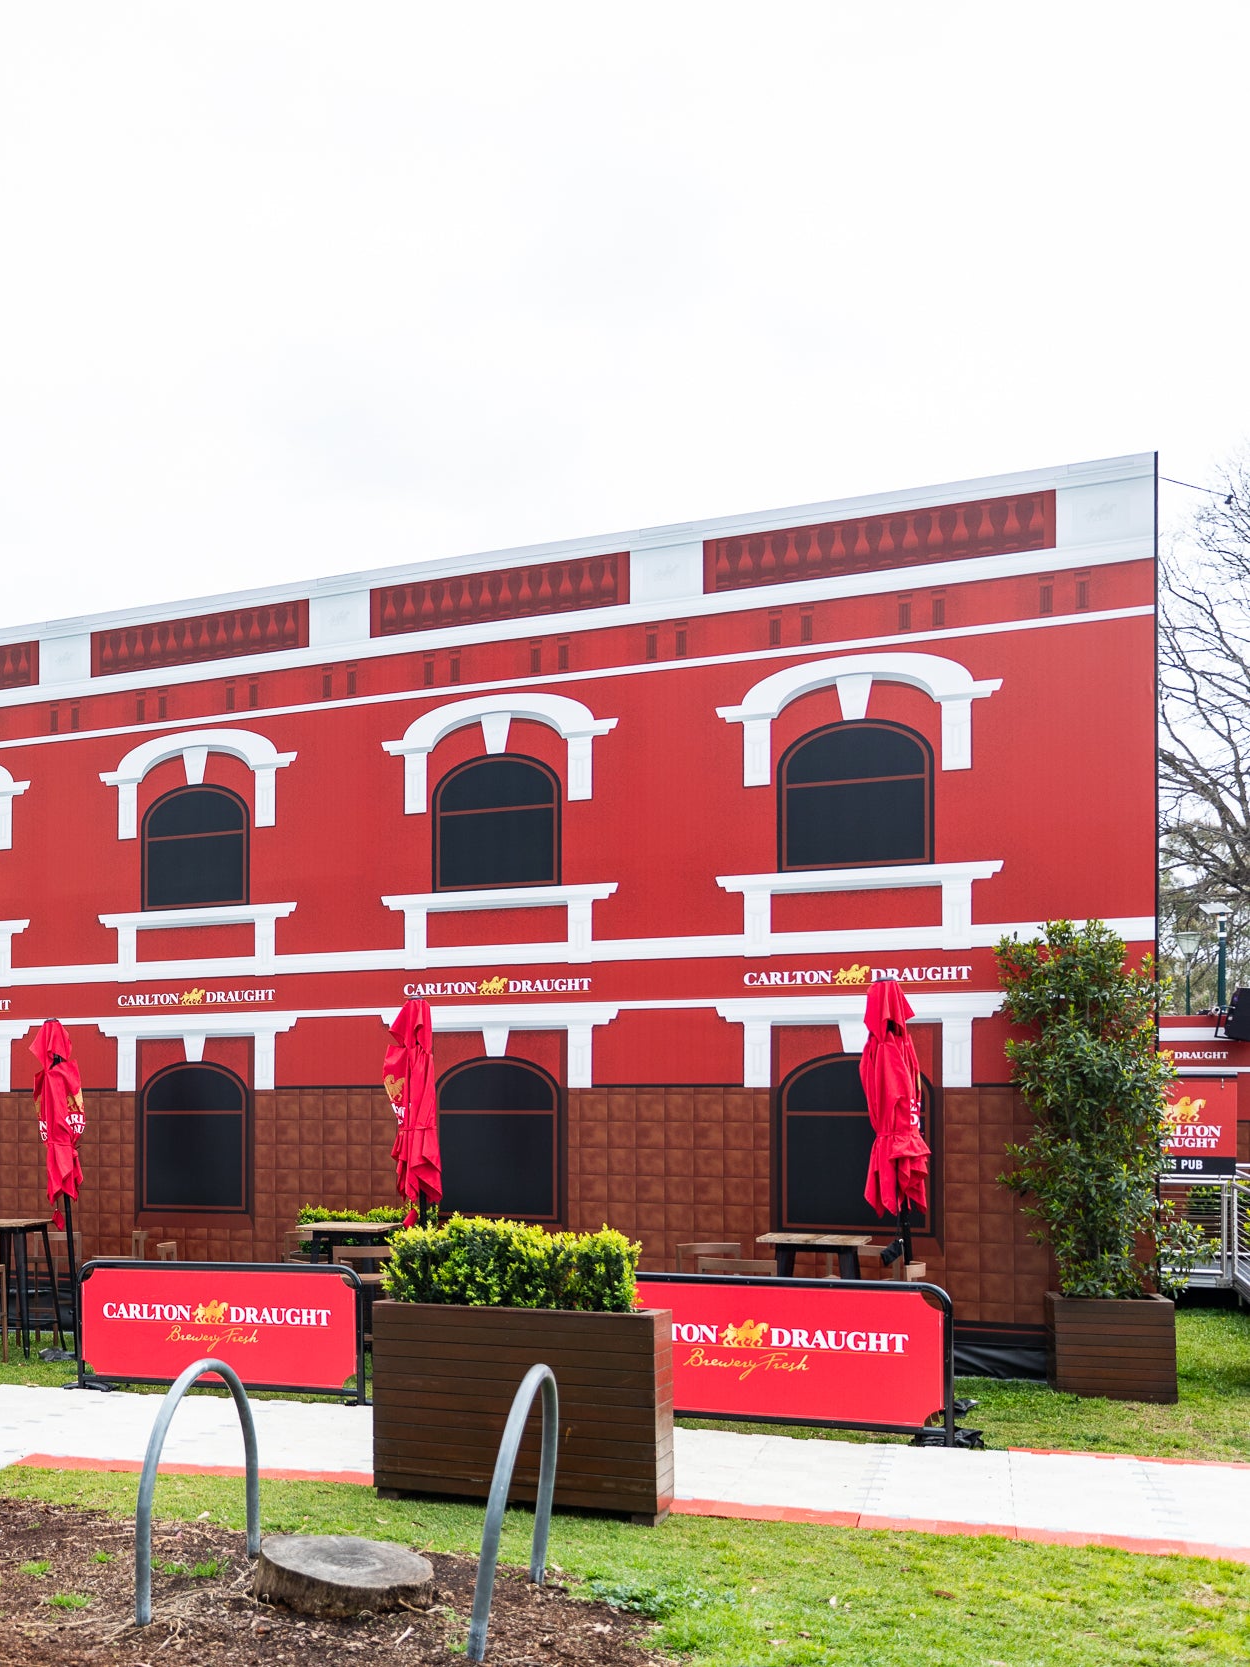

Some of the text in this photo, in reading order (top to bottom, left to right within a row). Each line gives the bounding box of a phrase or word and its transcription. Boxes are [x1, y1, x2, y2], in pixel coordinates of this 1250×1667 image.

[403, 977, 592, 996] CARLTON DRAUGHT
[743, 969, 833, 986] CARLTON
[117, 989, 276, 1007] CARLTON DRAUGHT
[1174, 1051, 1228, 1060] DRAUGHT
[1168, 1125, 1222, 1137] LTON
[1162, 1138, 1218, 1148] AUGHT
[1181, 1160, 1203, 1170] PUB
[102, 1302, 331, 1327] CARLTON DRAUGHT
[165, 1324, 259, 1352] Brewery Fresh
[770, 1327, 909, 1353] DRAUGHT
[683, 1347, 810, 1380] Brewery Fresh
